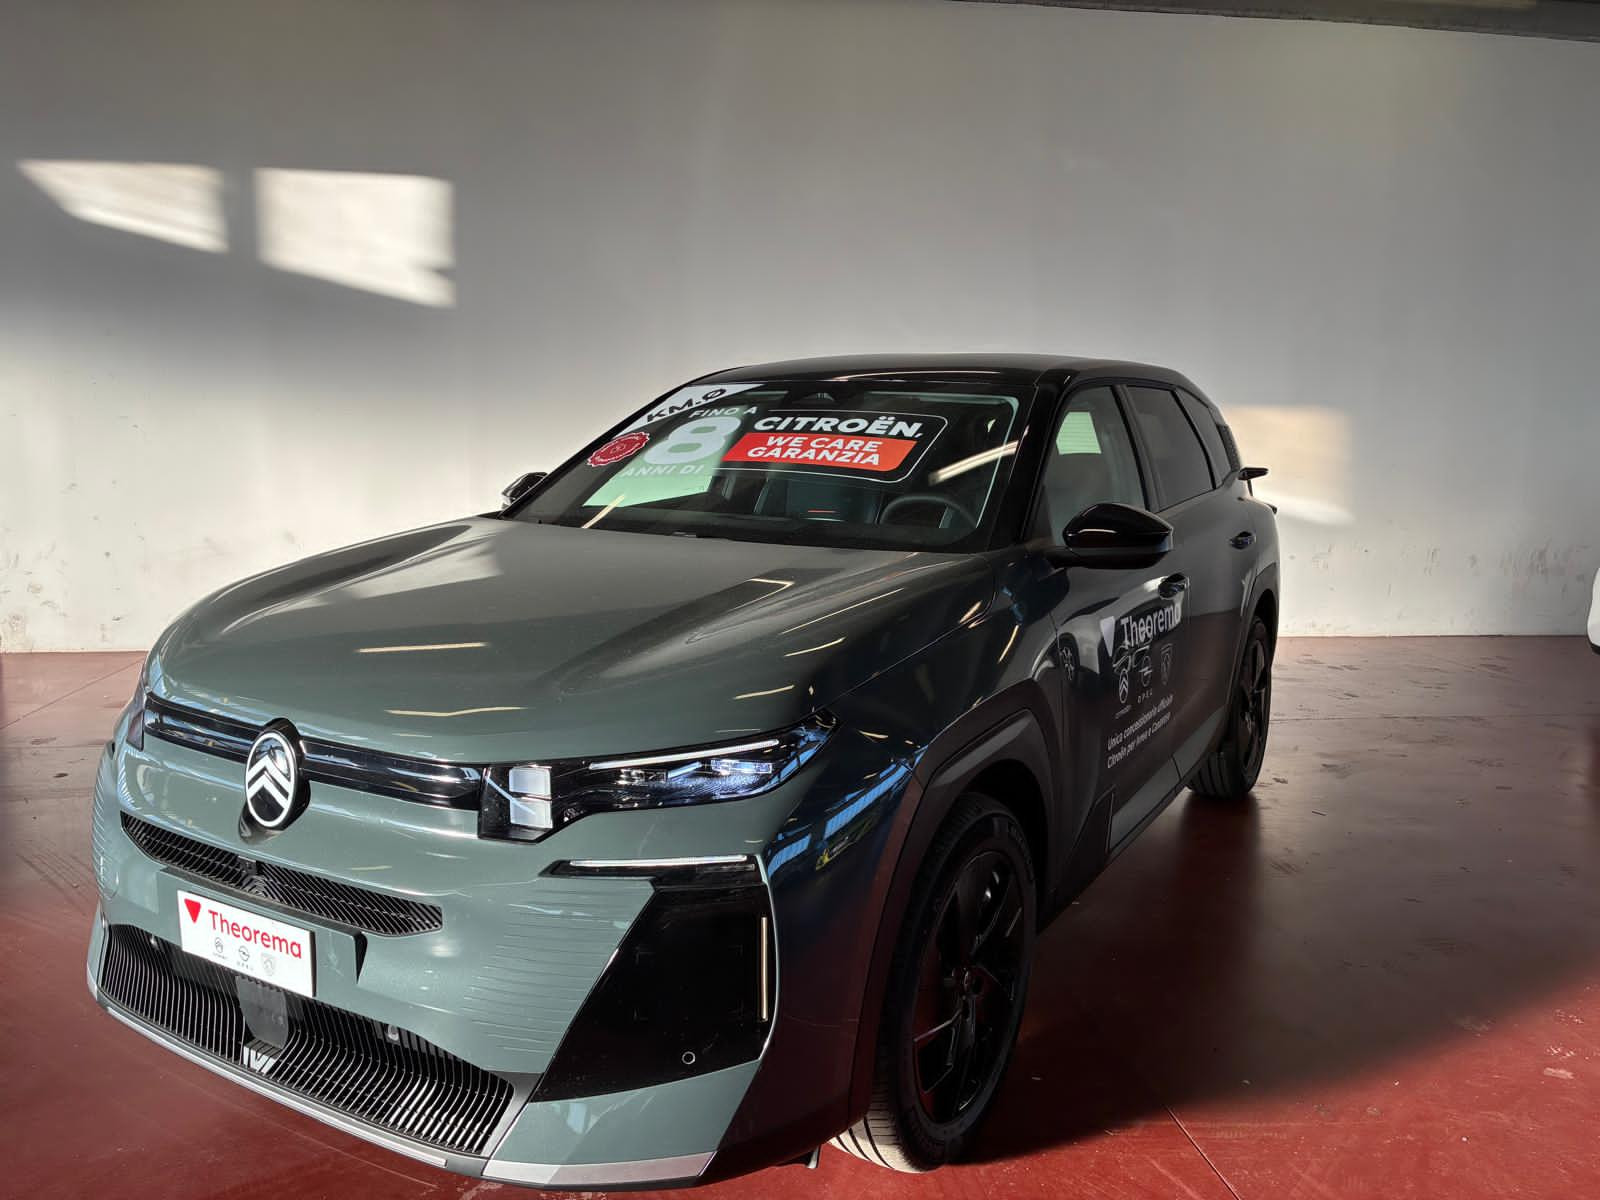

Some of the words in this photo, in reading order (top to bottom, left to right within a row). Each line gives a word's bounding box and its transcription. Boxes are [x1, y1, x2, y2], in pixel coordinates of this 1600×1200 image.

[688, 407, 739, 418] FINO
[744, 406, 758, 415] A
[643, 416, 742, 465] 8
[767, 436, 808, 447] WE
[810, 437, 883, 452] CARE
[747, 447, 880, 465] GARANZIA
[621, 465, 673, 477] ANNI
[679, 465, 704, 475] DI
[208, 909, 302, 959] Theorema
